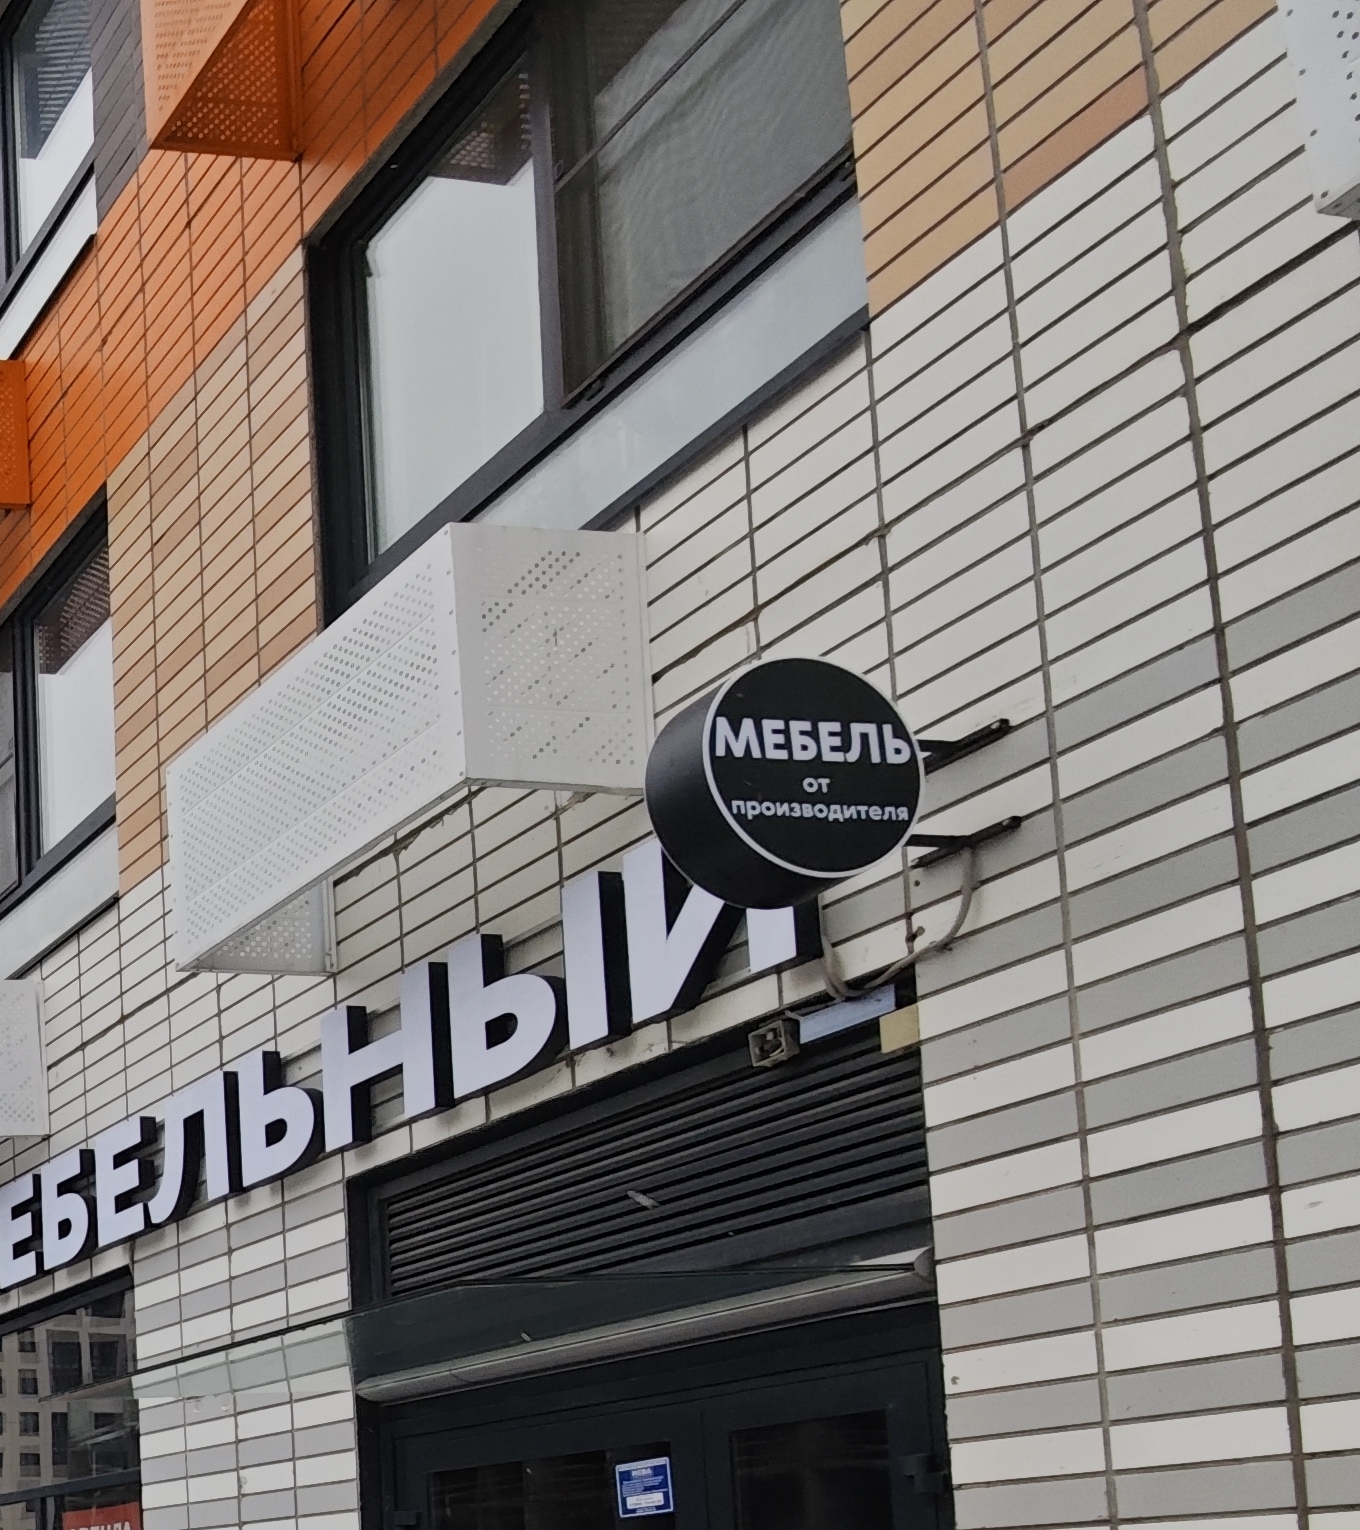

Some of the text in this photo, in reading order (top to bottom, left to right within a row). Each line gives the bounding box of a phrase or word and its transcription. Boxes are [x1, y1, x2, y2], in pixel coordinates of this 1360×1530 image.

[715, 716, 912, 765] МЕБЕЛЬ
[802, 777, 831, 793] от
[730, 799, 910, 823] производителя
